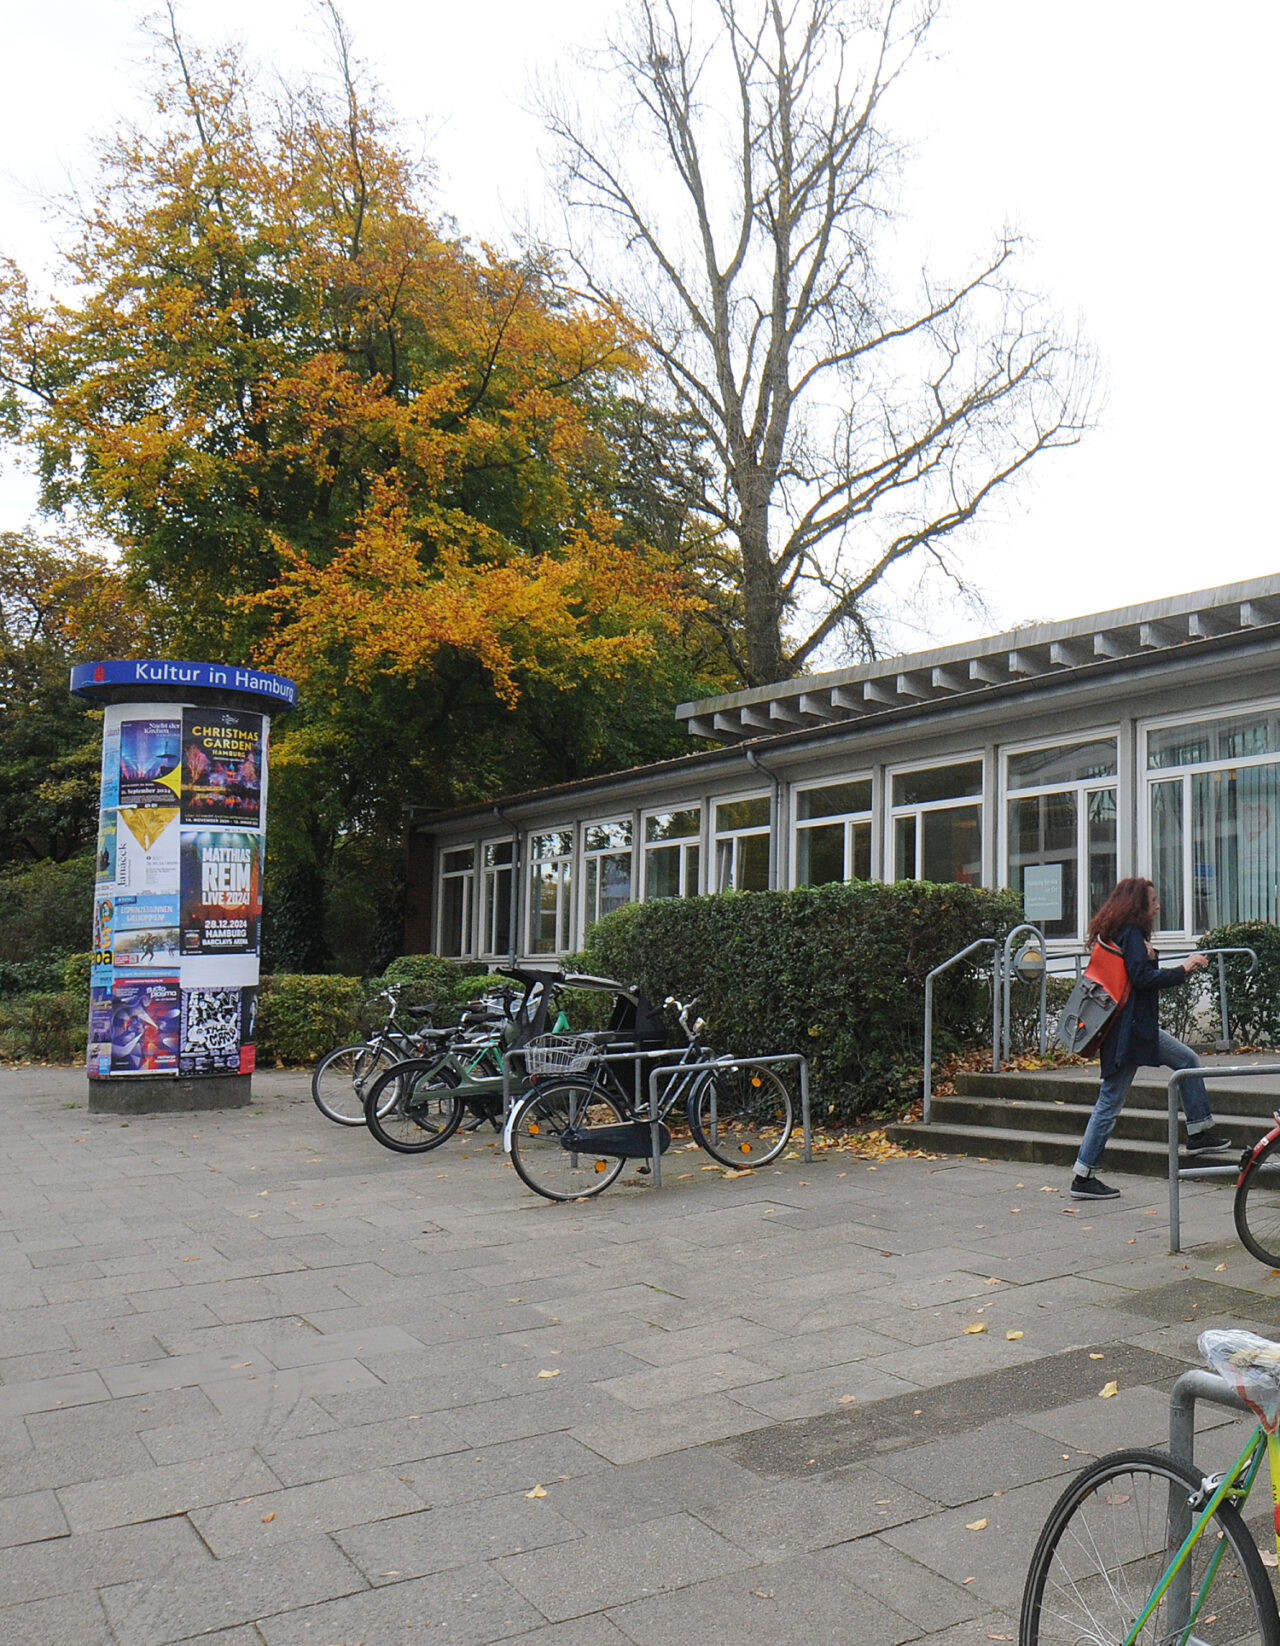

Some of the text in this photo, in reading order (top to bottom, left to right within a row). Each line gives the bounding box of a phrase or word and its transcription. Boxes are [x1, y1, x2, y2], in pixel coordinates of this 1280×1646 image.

[135, 663, 294, 701] Kultur in Hamburg
[192, 726, 259, 742] CHRISTMAS
[203, 738, 252, 751] GARDEN
[212, 749, 246, 758] HAMBURG
[202, 847, 251, 862] MATTHIAS
[202, 862, 251, 891] REIM
[202, 891, 250, 905] LIVE 2024
[204, 920, 248, 929] 28.12.2024
[205, 929, 247, 938] HAMBURG
[202, 938, 233, 946] BARCLAYS
